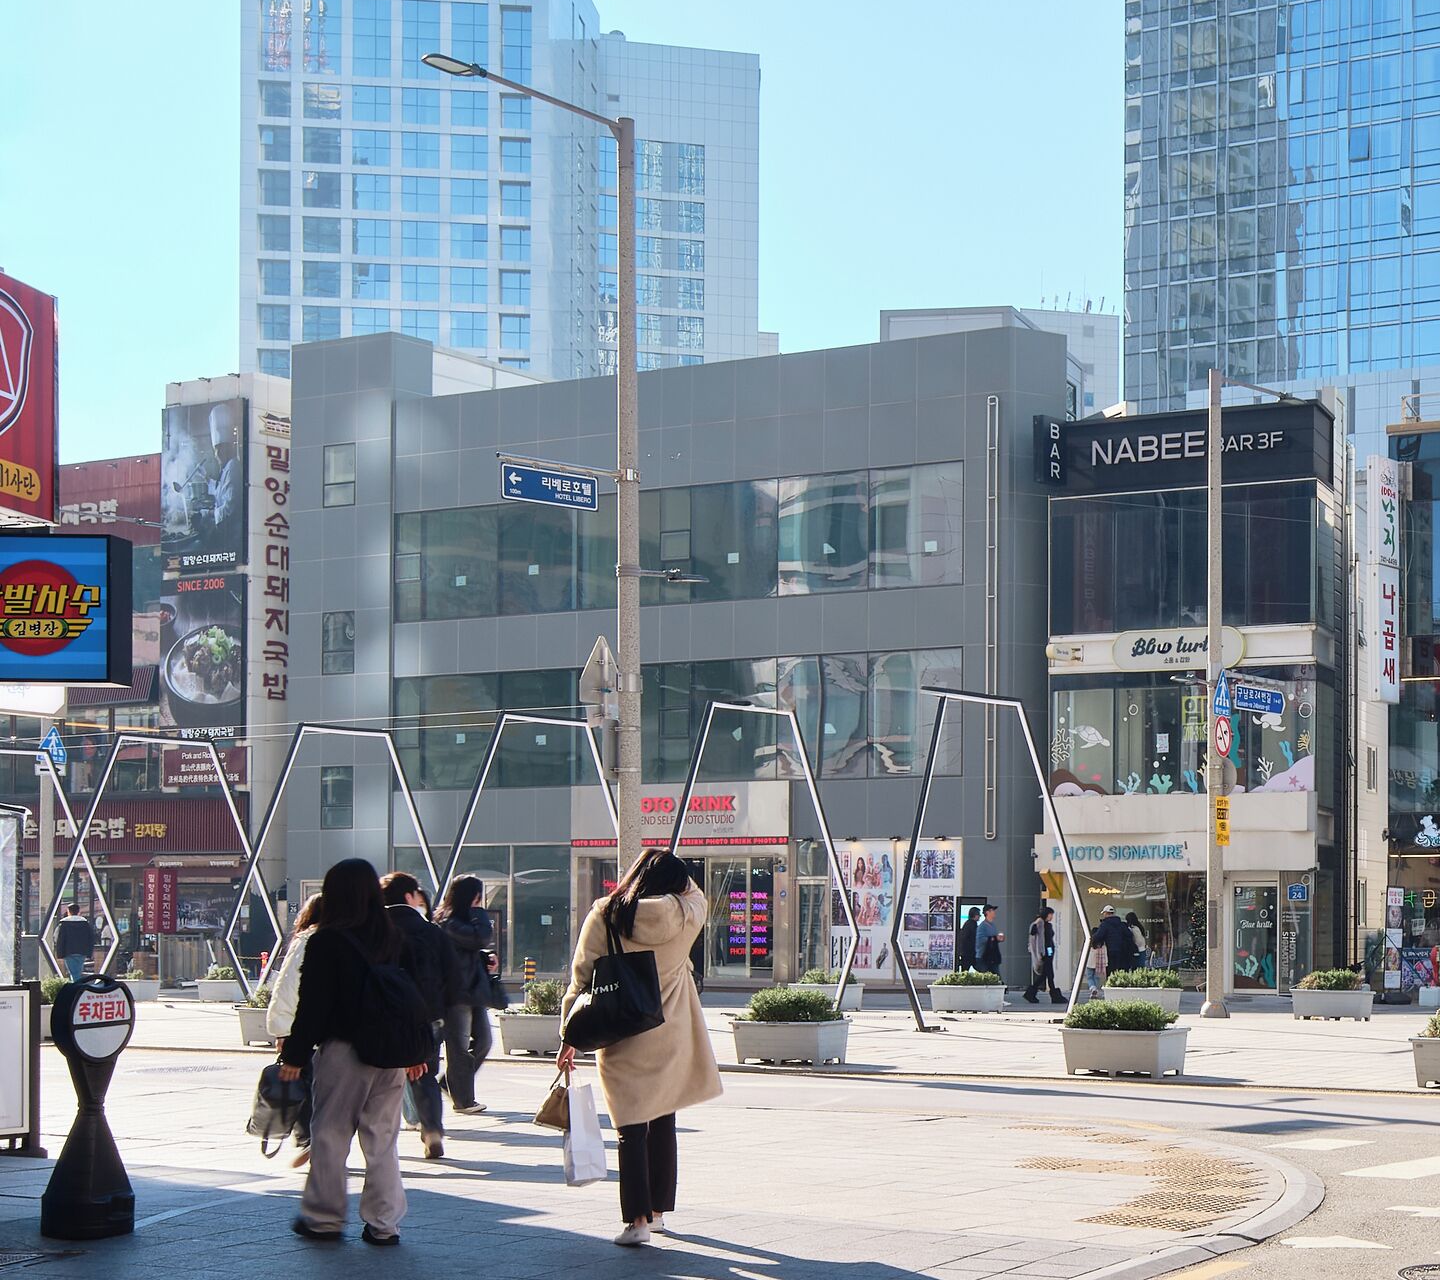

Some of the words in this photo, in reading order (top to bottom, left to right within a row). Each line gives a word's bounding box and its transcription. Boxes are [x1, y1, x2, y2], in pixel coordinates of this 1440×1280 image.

[1050, 422, 1061, 479] BAR
[1091, 430, 1206, 466] NABEE
[1258, 431, 1284, 450] 3F
[541, 476, 592, 496] 리베로호텔
[554, 493, 572, 502] HOTEL
[573, 496, 592, 504] LIBERO
[263, 444, 290, 701] 밀양순대돼지국밥
[177, 579, 203, 592] SINCE
[203, 578, 225, 591] 2006
[0, 583, 102, 616] 발사수
[13, 620, 59, 637] 김병장
[1176, 634, 1209, 653] turt
[641, 796, 675, 813] OTO
[684, 795, 736, 811] RINK
[657, 815, 675, 825] SELF
[705, 814, 735, 824] STUDIO
[1108, 844, 1184, 860] SIGNATURE
[79, 1000, 126, 1021] 주차금지
